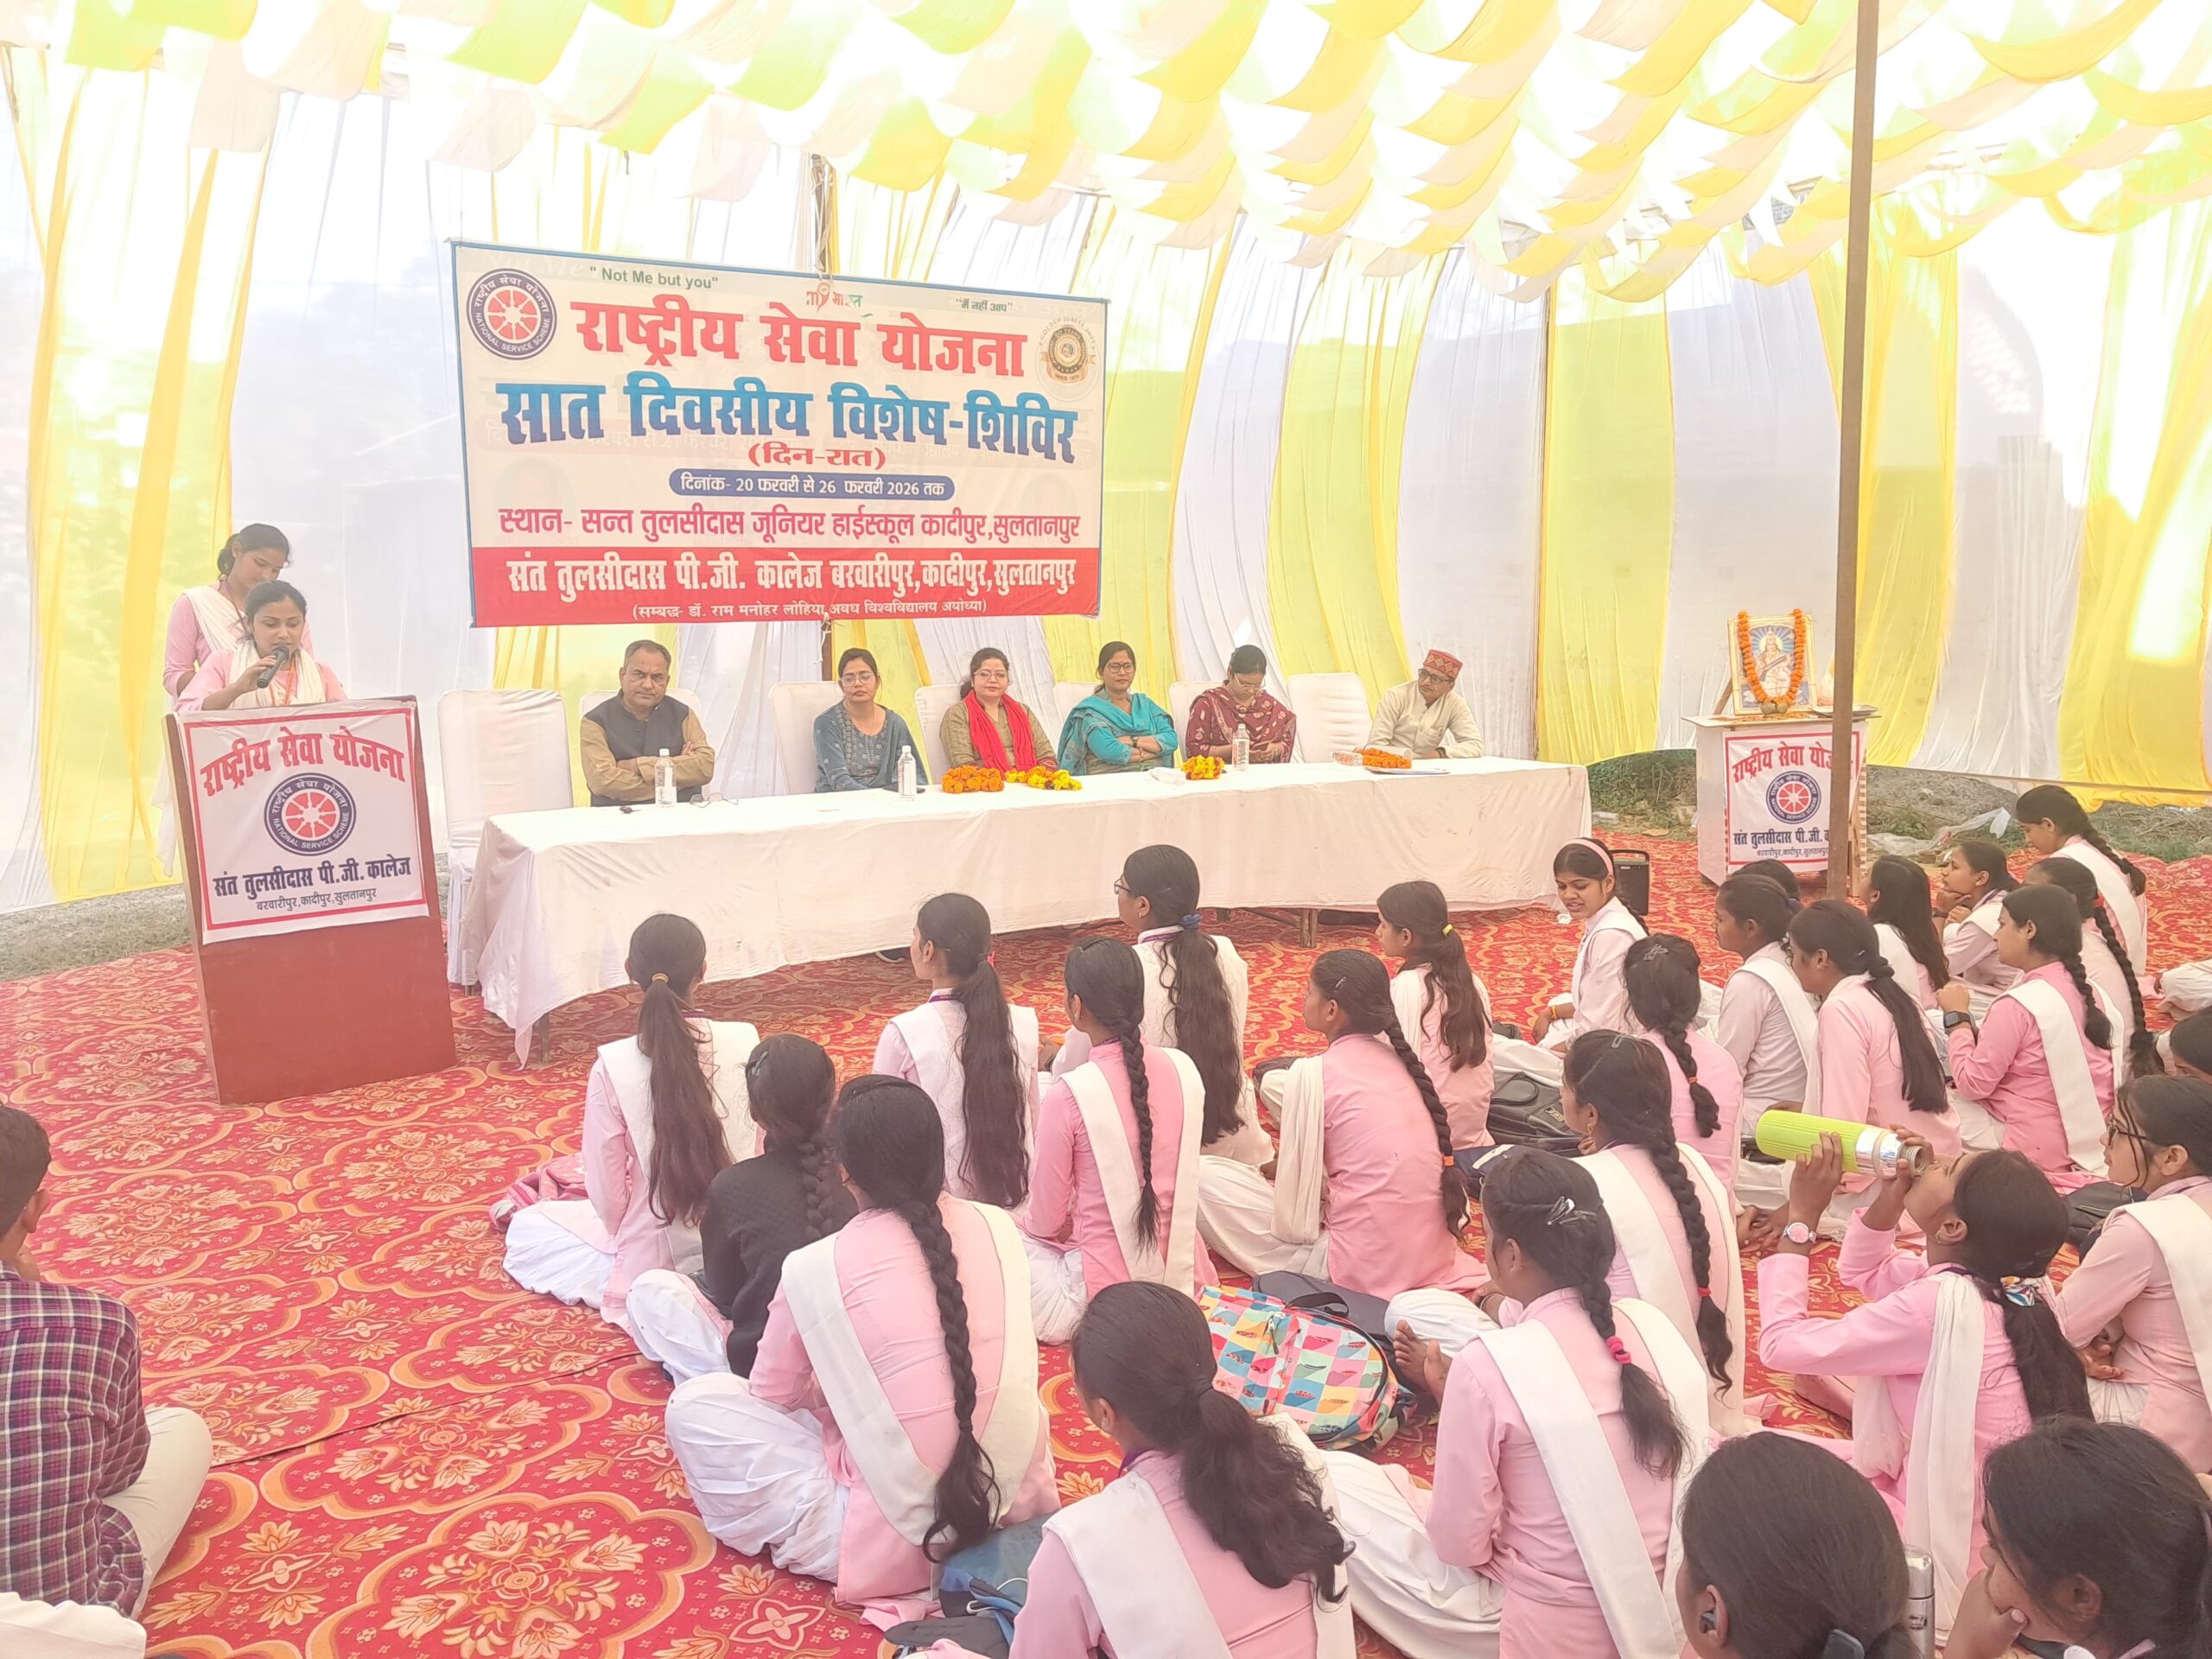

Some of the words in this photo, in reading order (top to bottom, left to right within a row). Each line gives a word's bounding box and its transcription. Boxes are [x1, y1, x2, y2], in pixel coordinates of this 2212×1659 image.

[474, 280, 497, 308] राष्ट्रीय
[499, 274, 522, 286] सेवा
[525, 283, 550, 313] योजना
[602, 268, 627, 283] Not
[632, 270, 652, 284] Me
[658, 271, 680, 286] but
[475, 312, 499, 347] NATIONAL
[501, 342, 534, 353] SERVICE
[532, 317, 551, 346] SCHEME
[570, 294, 744, 366] राष्ट्रीय
[760, 301, 861, 366] सेवा
[876, 311, 1027, 377] योजना
[495, 383, 606, 445] सात
[623, 371, 813, 437] दिवसीय
[828, 381, 1078, 464] विशेष-शिविर
[748, 441, 886, 470] (दिन-रात)
[680, 472, 731, 491] दिनांक-
[735, 478, 753, 492] 20
[757, 474, 799, 493] फरवरी
[803, 474, 815, 493] से
[819, 480, 836, 493] 26
[843, 478, 884, 495] फरवरी
[887, 481, 919, 496] 2026
[922, 482, 945, 496] तक
[499, 508, 572, 533] स्थान-
[581, 509, 633, 534] सन्त
[641, 502, 745, 542] तुलसीदास
[751, 504, 825, 543] जूनियर
[832, 505, 914, 543] हाईस्कूल
[506, 551, 547, 592] संत
[554, 551, 667, 602] तुलसीदास
[674, 551, 746, 592] पी.जी.
[754, 551, 823, 590] कालेज
[689, 603, 706, 617] डॉ.
[711, 605, 734, 616] राम
[739, 601, 779, 616] मनोहर
[830, 603, 860, 614] अवध
[864, 600, 938, 614] विश्वविद्यालय
[942, 597, 988, 613] अयोध्या)
[200, 737, 270, 798] राष्ट्रीय
[277, 726, 324, 768] सेवा
[329, 725, 405, 782] योजना
[1732, 747, 1773, 783] राष्ट्रीय
[1777, 741, 1804, 766] सेवा
[295, 779, 319, 788] सेवा
[322, 783, 348, 808] योजना
[272, 817, 299, 847] NATIONAL
[301, 836, 334, 849] SERVICE
[333, 811, 350, 839] SCHEME
[1733, 830, 1747, 845] संत
[1751, 829, 1792, 849] तुलसीदास
[213, 871, 238, 897] संत
[243, 866, 314, 899] तुलसीदास
[317, 857, 365, 885] पी.जी.
[366, 854, 412, 878] कालेज
